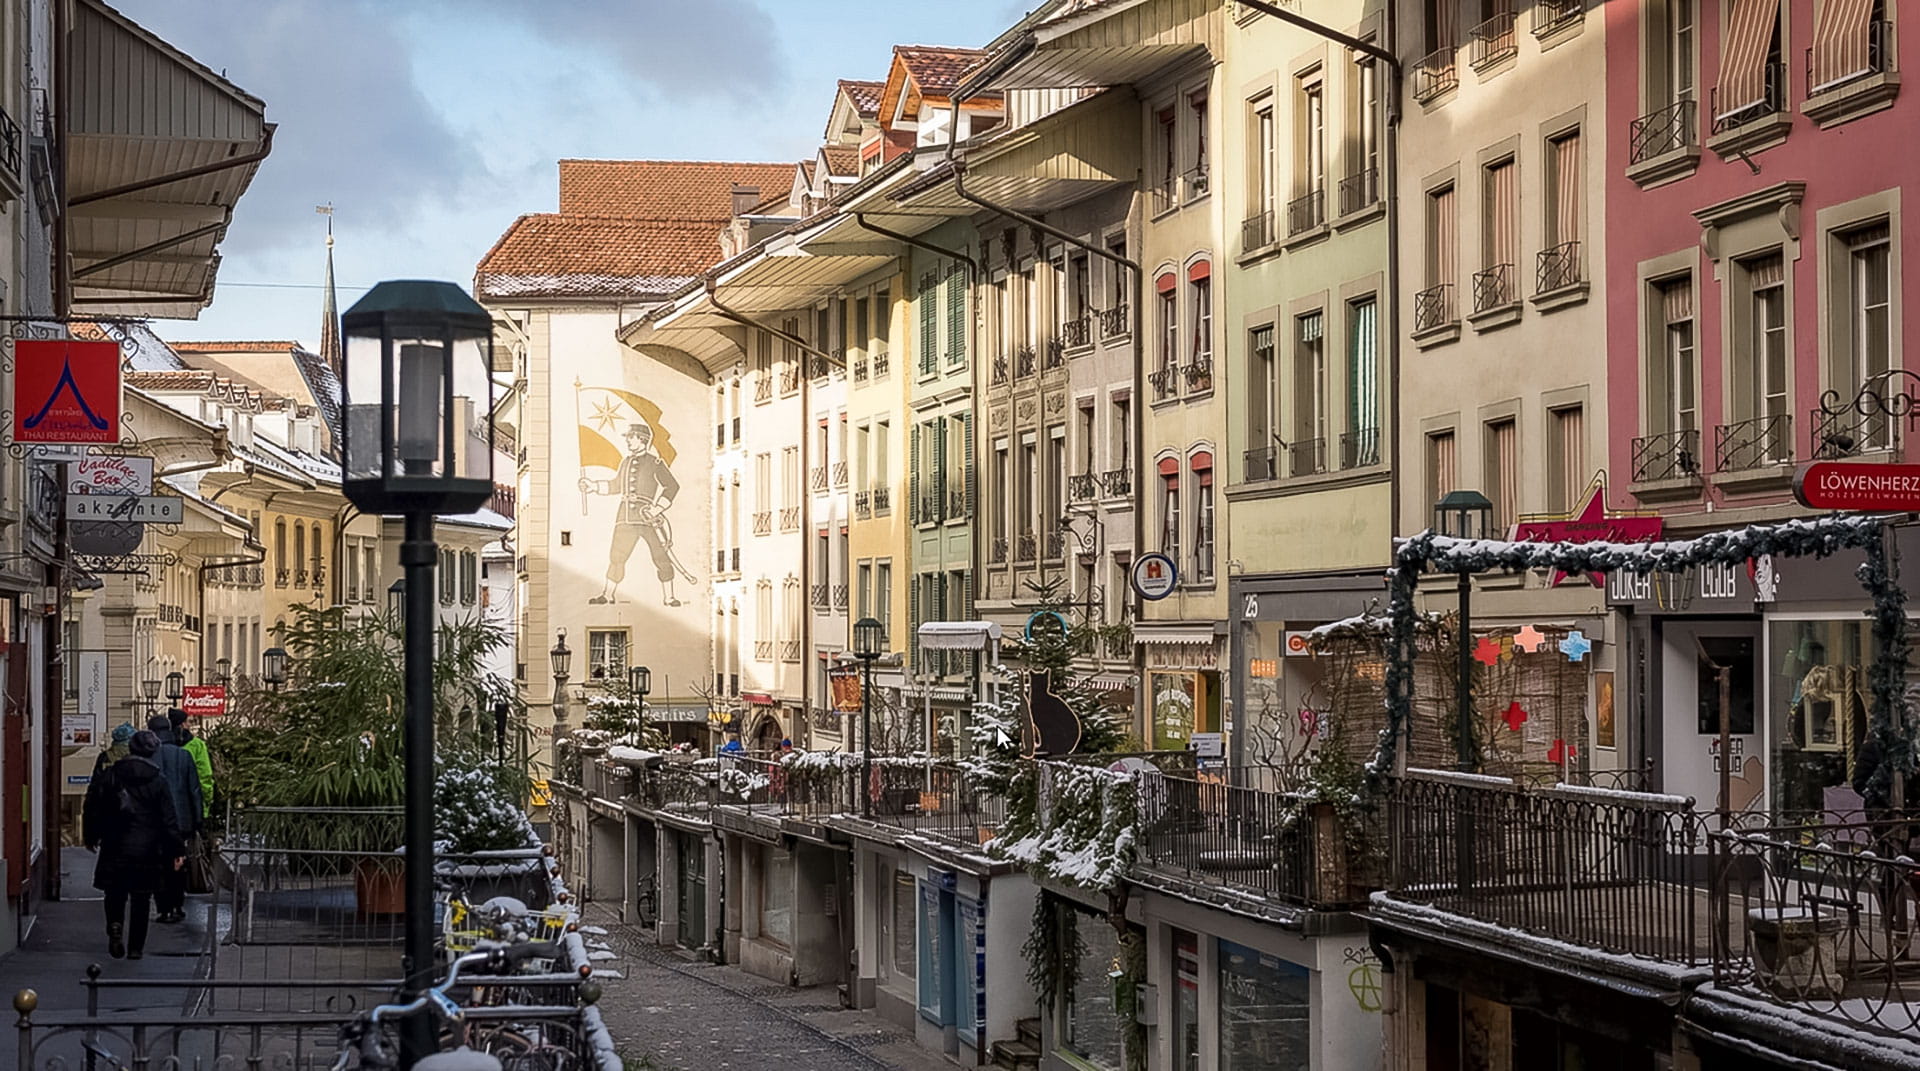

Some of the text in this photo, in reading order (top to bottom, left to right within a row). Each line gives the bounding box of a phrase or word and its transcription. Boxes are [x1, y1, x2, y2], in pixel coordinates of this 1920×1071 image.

[24, 432, 108, 441] THAI RESTAURANT
[79, 457, 136, 477] Cadillac
[93, 471, 121, 486] Bar
[1820, 472, 1920, 491] LÖWENHERZ
[1820, 492, 1920, 500] HOLZSPIELWAREN
[78, 500, 170, 516] akzente
[1245, 594, 1258, 618] 25
